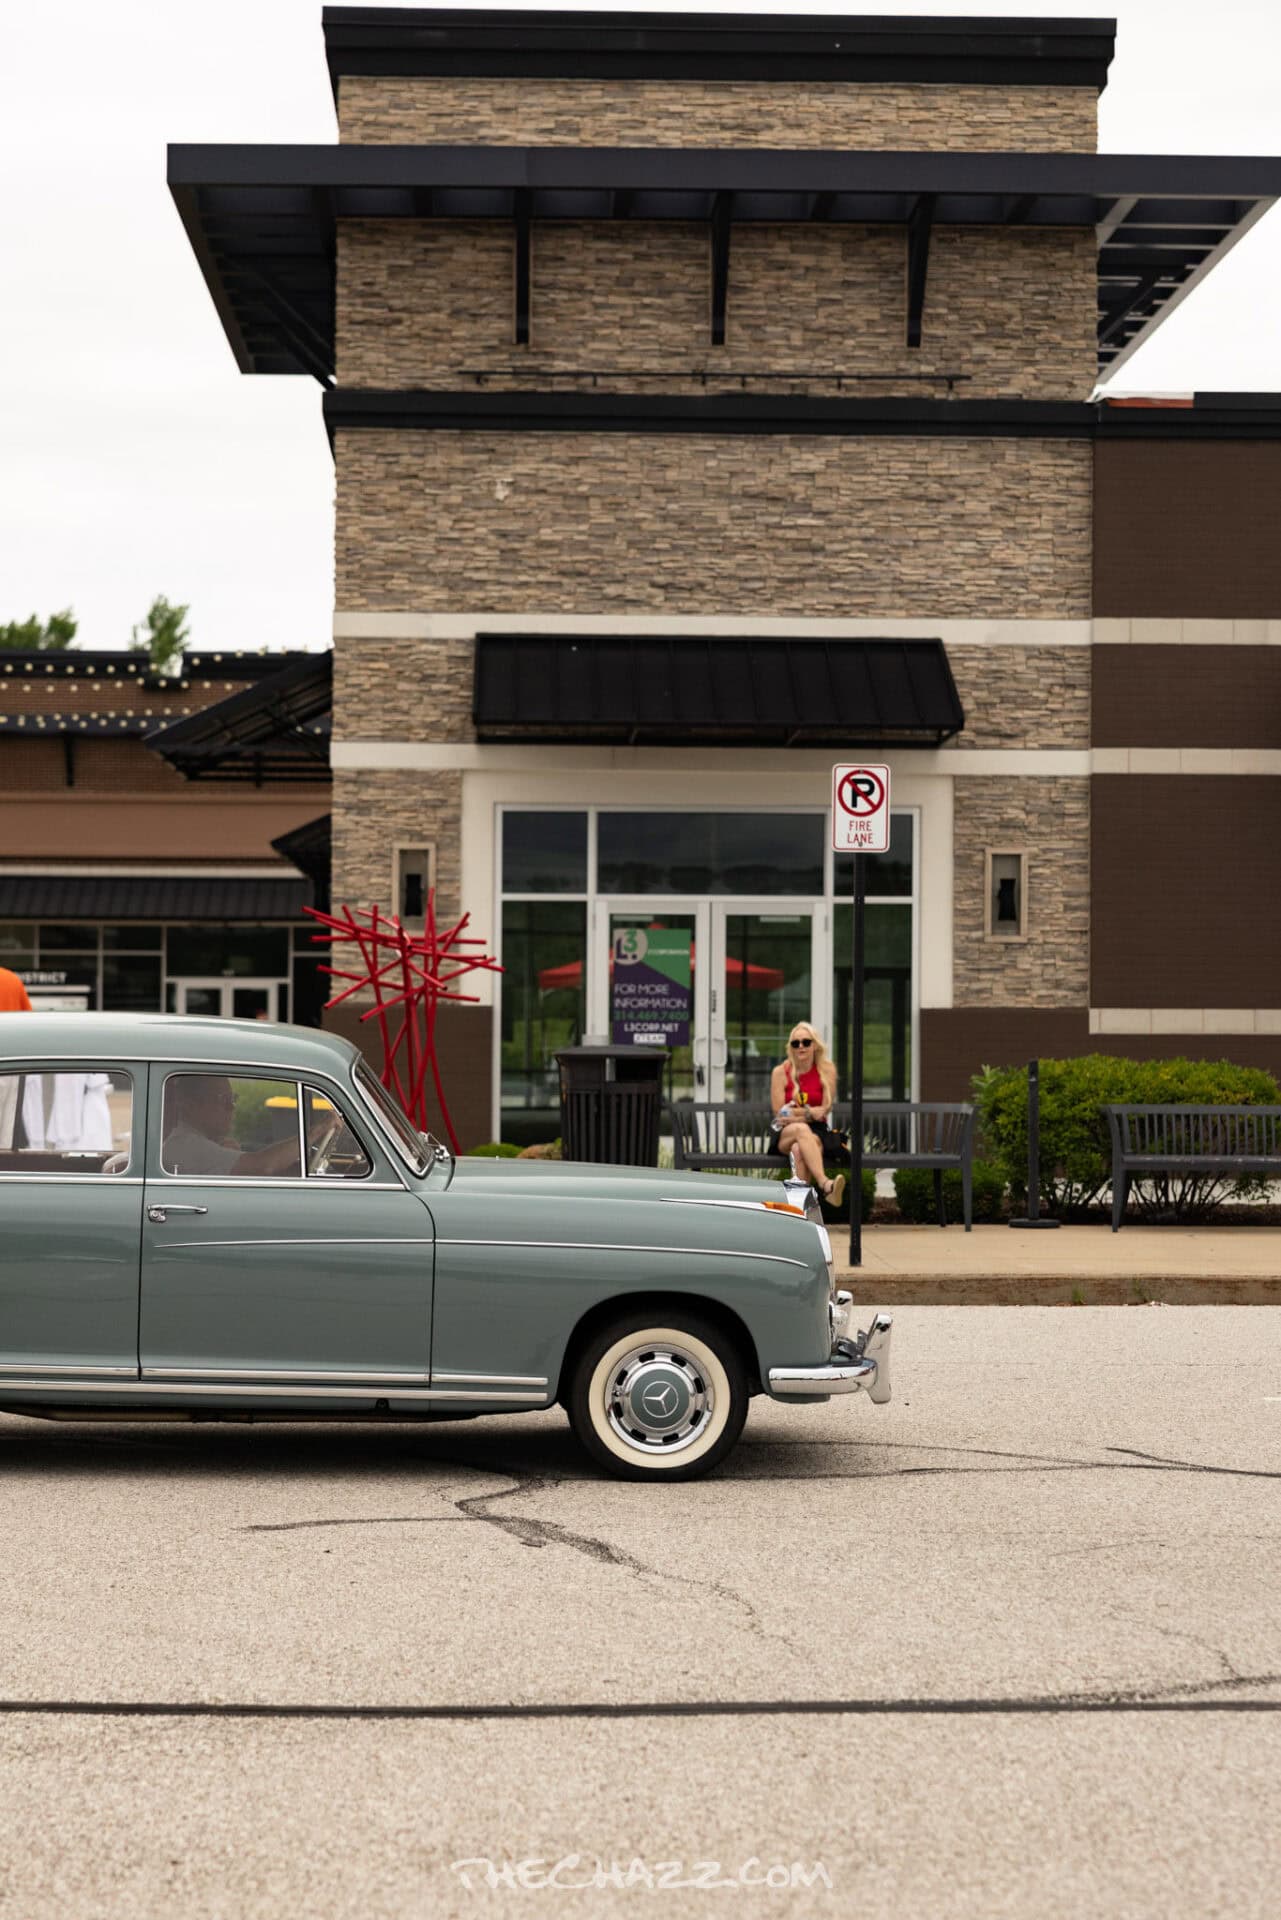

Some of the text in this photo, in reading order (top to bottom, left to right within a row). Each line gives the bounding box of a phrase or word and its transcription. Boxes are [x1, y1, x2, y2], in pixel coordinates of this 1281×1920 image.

[849, 820, 873, 832] FIRE
[847, 832, 874, 845] LANE
[614, 983, 670, 995] FOR MORE
[614, 997, 688, 1009] INFORMATION
